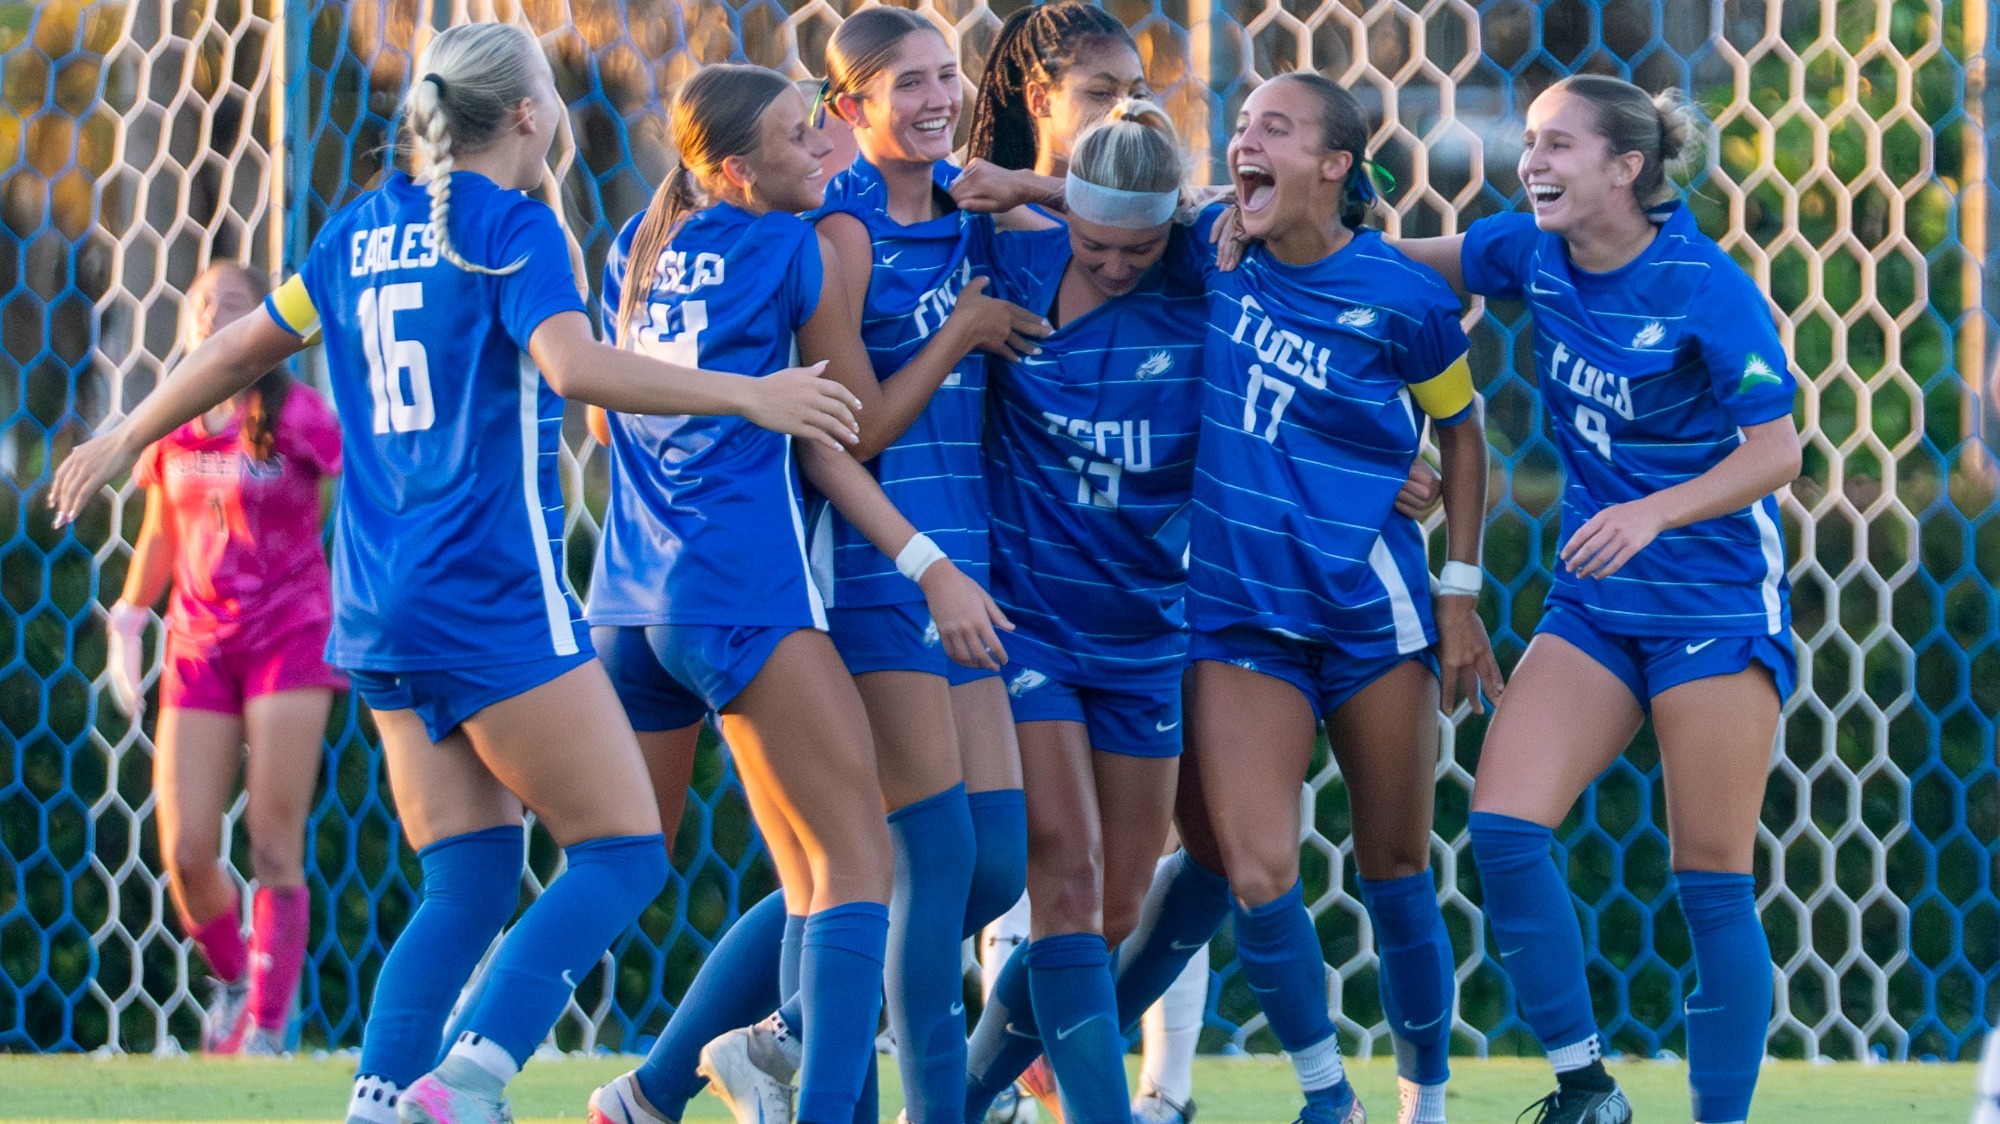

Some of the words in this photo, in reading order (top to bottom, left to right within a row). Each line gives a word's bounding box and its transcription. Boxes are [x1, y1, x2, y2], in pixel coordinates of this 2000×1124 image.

[350, 221, 440, 277] EAGLES
[357, 281, 435, 434] 16
[1231, 294, 1332, 390] FGCU
[1242, 363, 1296, 444] 17
